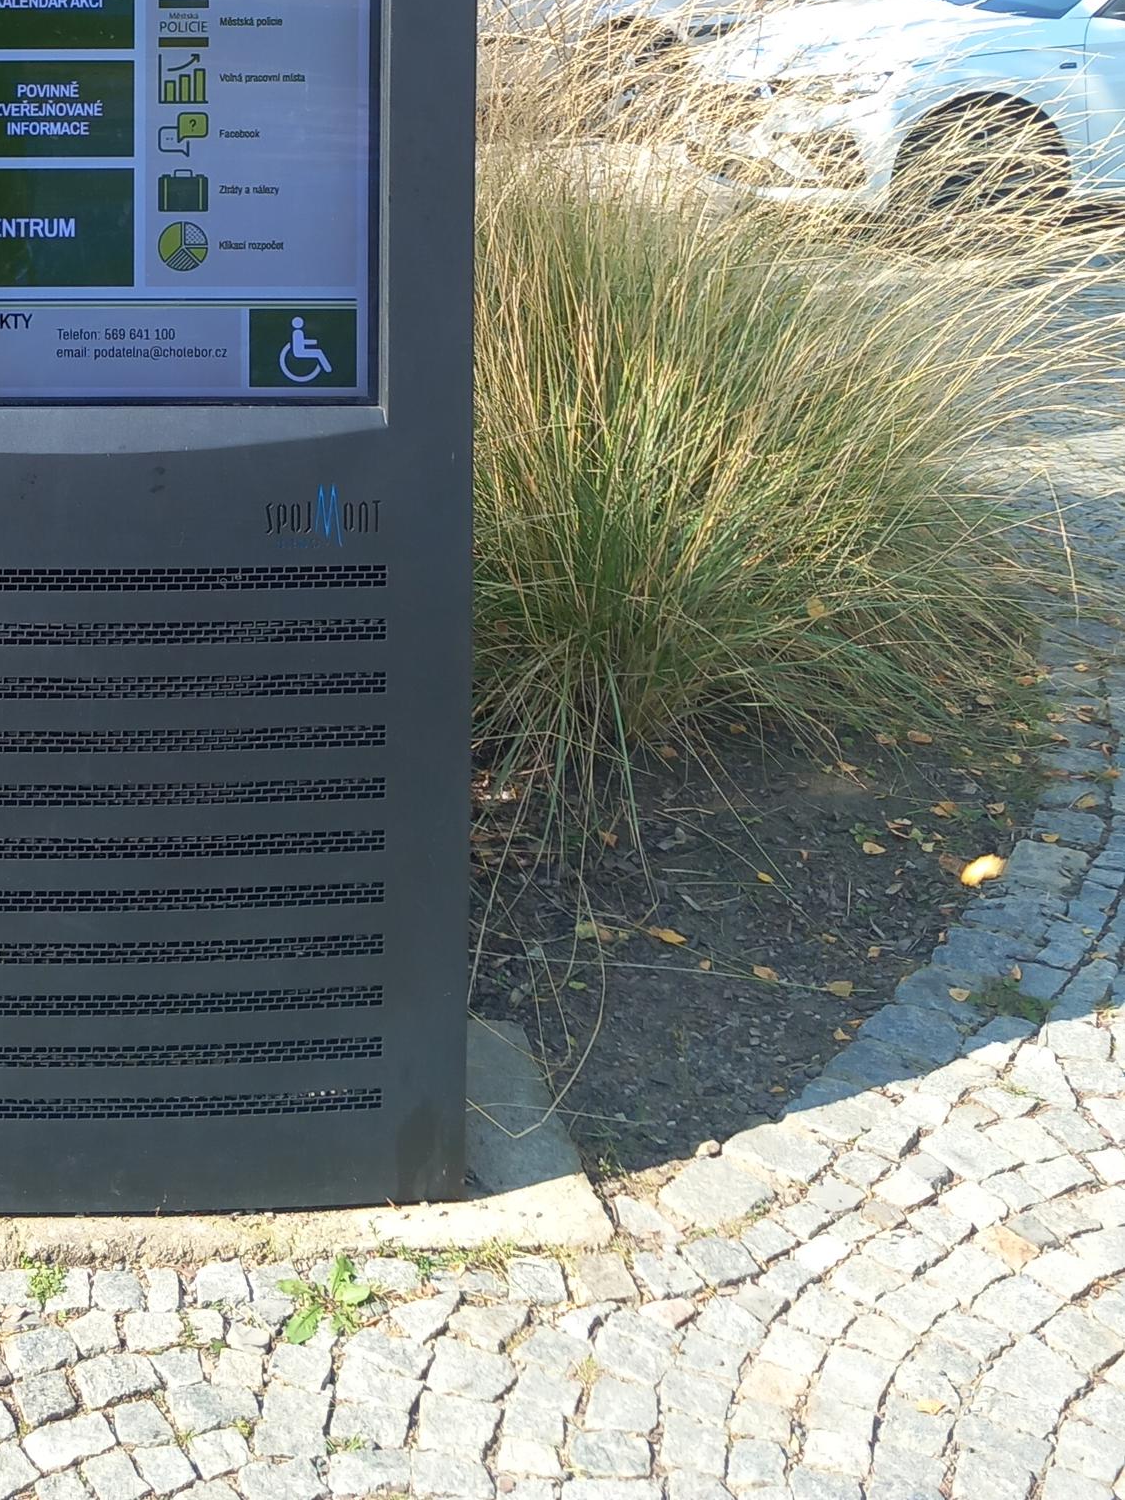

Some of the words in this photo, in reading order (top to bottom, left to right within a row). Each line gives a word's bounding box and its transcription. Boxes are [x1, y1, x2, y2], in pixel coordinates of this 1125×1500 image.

[169, 12, 199, 20] Městská
[220, 16, 255, 27] Městská
[256, 17, 283, 28] policie
[160, 21, 209, 33] POLICIE
[219, 73, 243, 83] Volná
[245, 73, 281, 84] pracovní
[282, 73, 306, 83] místa
[17, 81, 80, 98] POVINNĚ
[7, 122, 90, 136] INFORMACE
[219, 129, 260, 139] Facebook
[219, 185, 243, 196] Ztráty
[245, 187, 251, 195] a
[253, 185, 280, 196] nálezy
[219, 241, 247, 250] Klikací
[248, 241, 284, 252] rozpočet
[56, 328, 101, 341] Telefon:
[104, 328, 126, 341] 569
[129, 328, 150, 341] 641
[155, 328, 176, 341] 100
[56, 346, 91, 358] email:
[94, 346, 228, 360] podatelna@chotebor.cz
